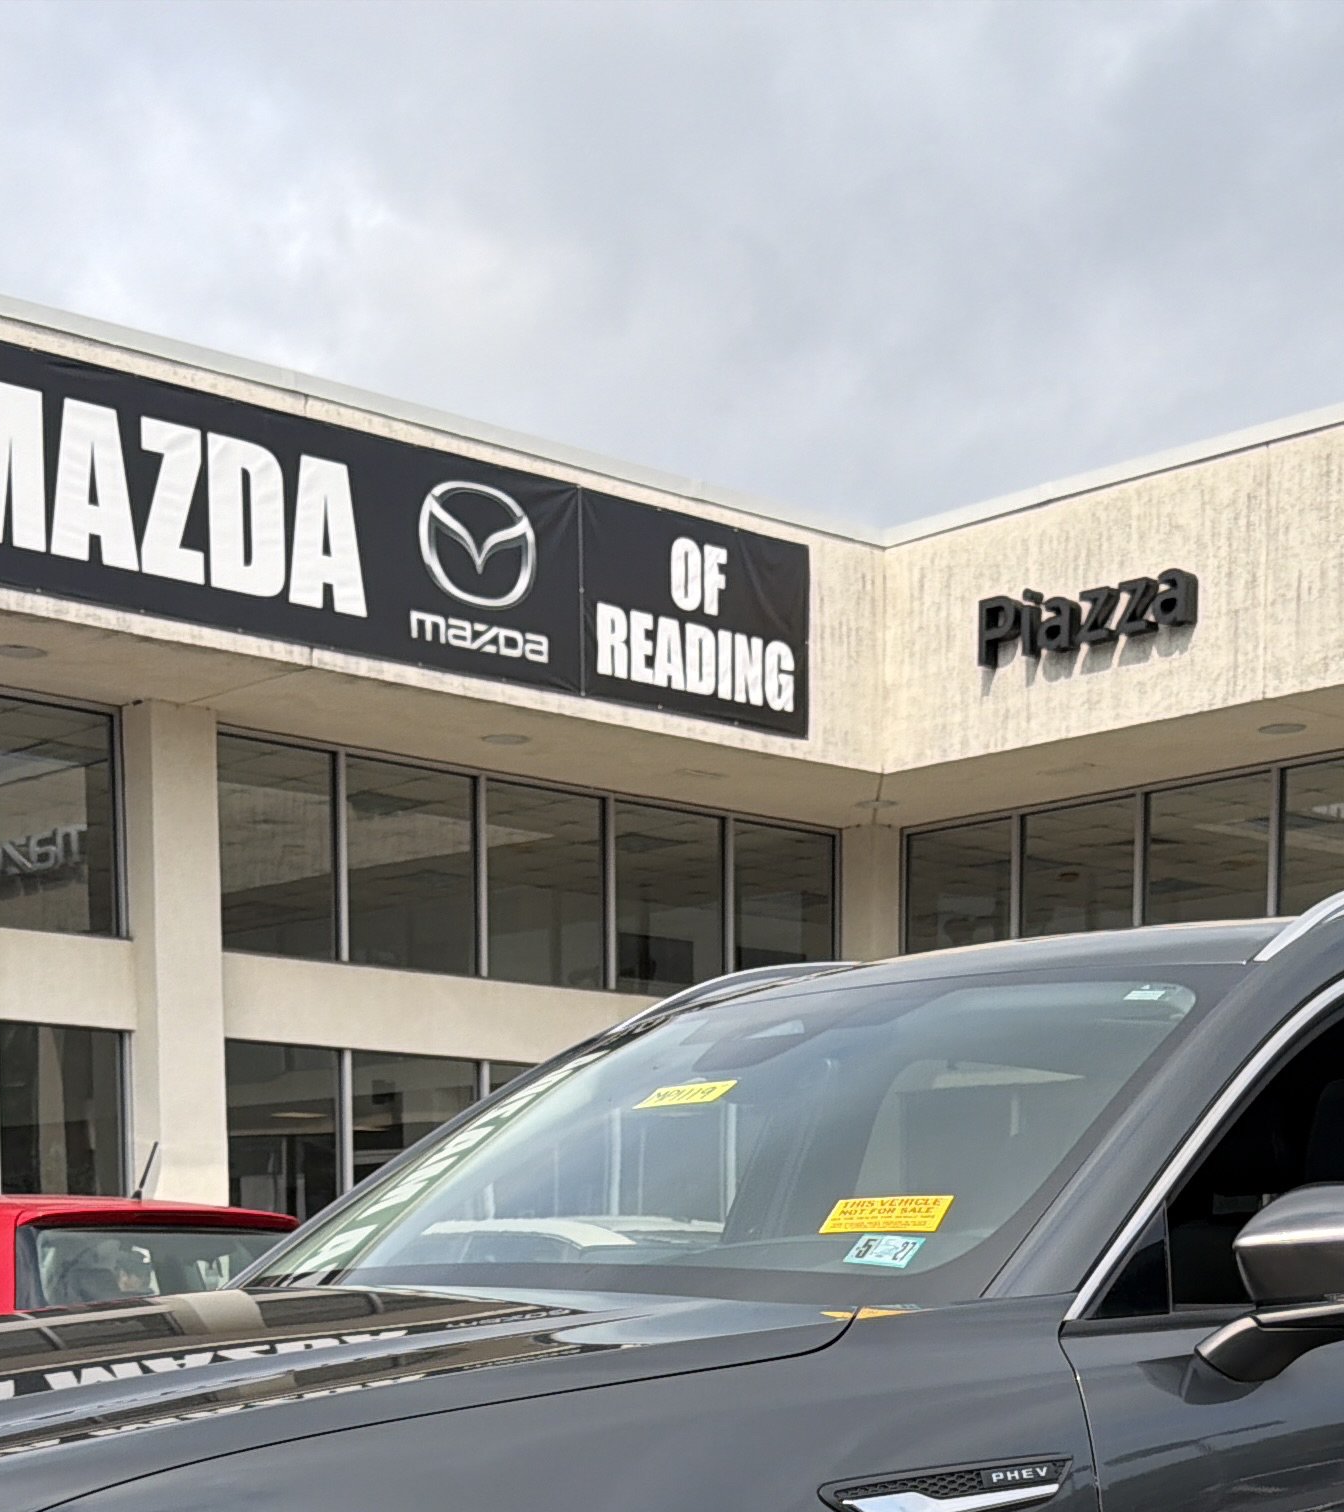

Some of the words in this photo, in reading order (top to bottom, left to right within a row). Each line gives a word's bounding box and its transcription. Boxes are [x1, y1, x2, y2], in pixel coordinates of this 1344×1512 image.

[670, 536, 728, 616] OF
[409, 608, 549, 664] mazda
[978, 568, 1199, 669] Piazza
[596, 601, 795, 713] READING
[839, 1209, 865, 1217] NOT
[869, 1207, 897, 1215] FOR
[900, 1206, 935, 1214] SALE
[842, 1200, 875, 1208] THIS
[879, 1198, 942, 1207] VEHICLE
[991, 1466, 1048, 1483] PHEV
